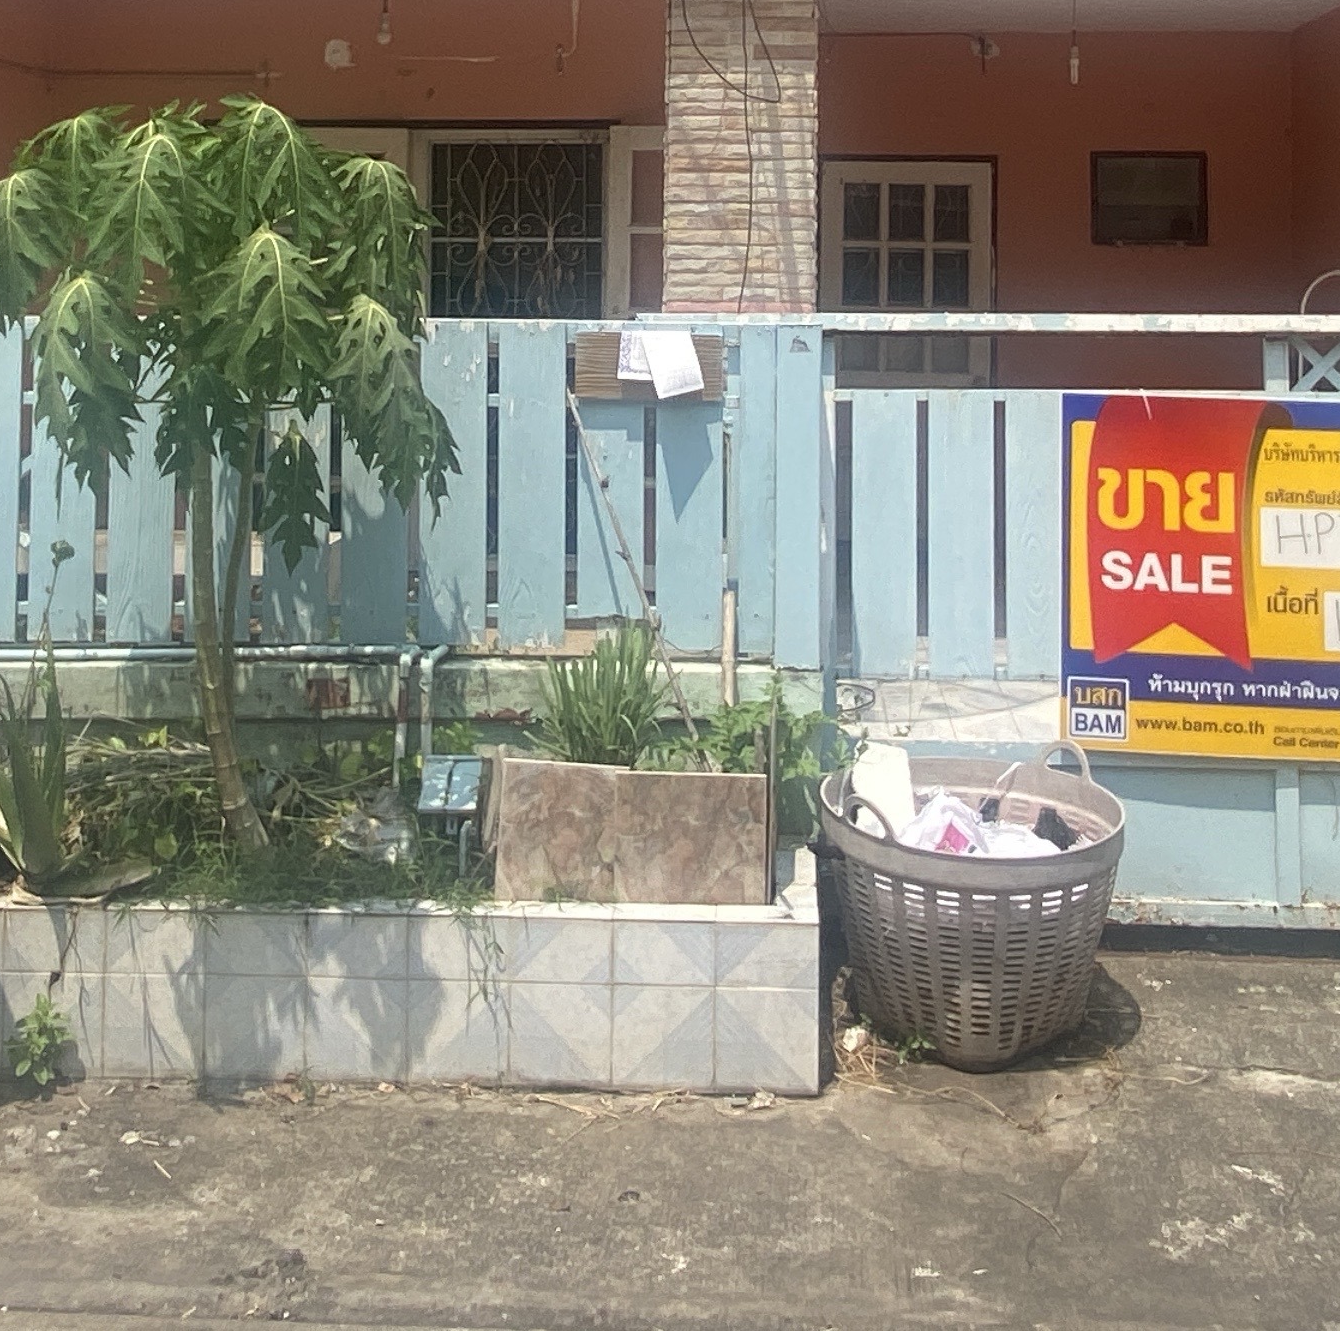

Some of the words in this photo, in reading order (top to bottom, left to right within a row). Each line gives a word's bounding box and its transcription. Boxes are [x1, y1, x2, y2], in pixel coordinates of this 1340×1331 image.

[1097, 467, 1235, 533] ขาย
[1101, 550, 1232, 595] SALE
[1266, 585, 1319, 616] เนื้อที่
[1075, 685, 1122, 707] บสก
[1148, 673, 1234, 701] ห้ามบุกรุก
[1074, 713, 1122, 734] BAM
[1136, 717, 1265, 735] www.bam.co.th
[1273, 736, 1296, 747] Call
[1299, 737, 1340, 750] Center
